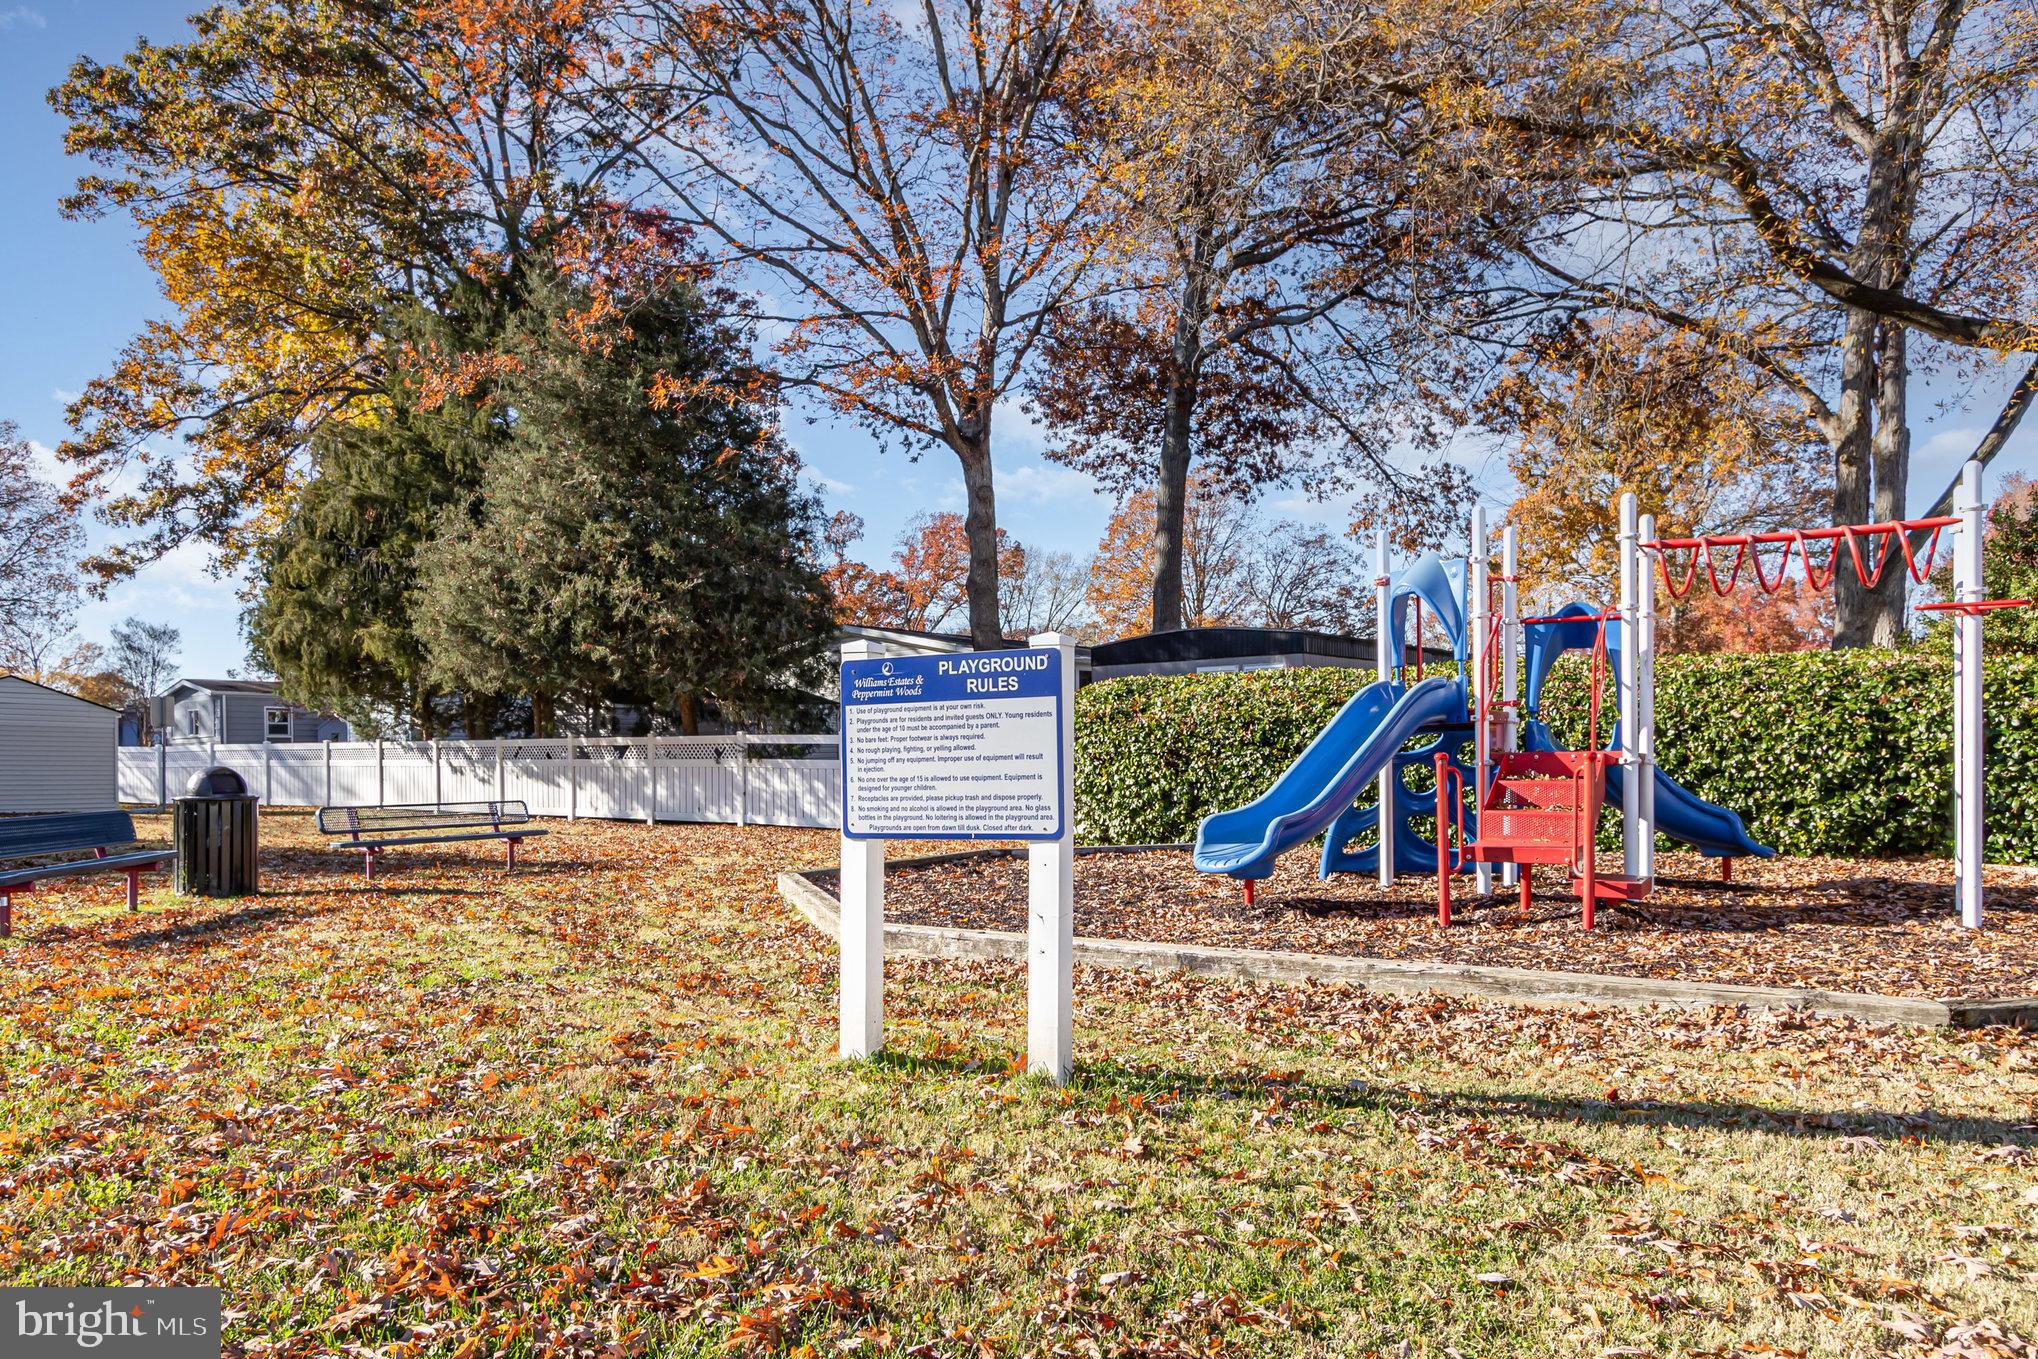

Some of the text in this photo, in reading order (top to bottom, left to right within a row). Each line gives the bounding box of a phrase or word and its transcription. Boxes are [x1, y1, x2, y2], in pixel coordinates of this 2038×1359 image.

[939, 656, 1048, 675] PLAYGROUND
[854, 675, 924, 687] Williams Estates &
[967, 677, 1018, 692] RULES
[852, 686, 922, 700] Peppermint Woods
[965, 713, 984, 721] guests
[929, 723, 965, 732] accompanied
[937, 755, 963, 764] Improper
[1006, 814, 1038, 822] playground
